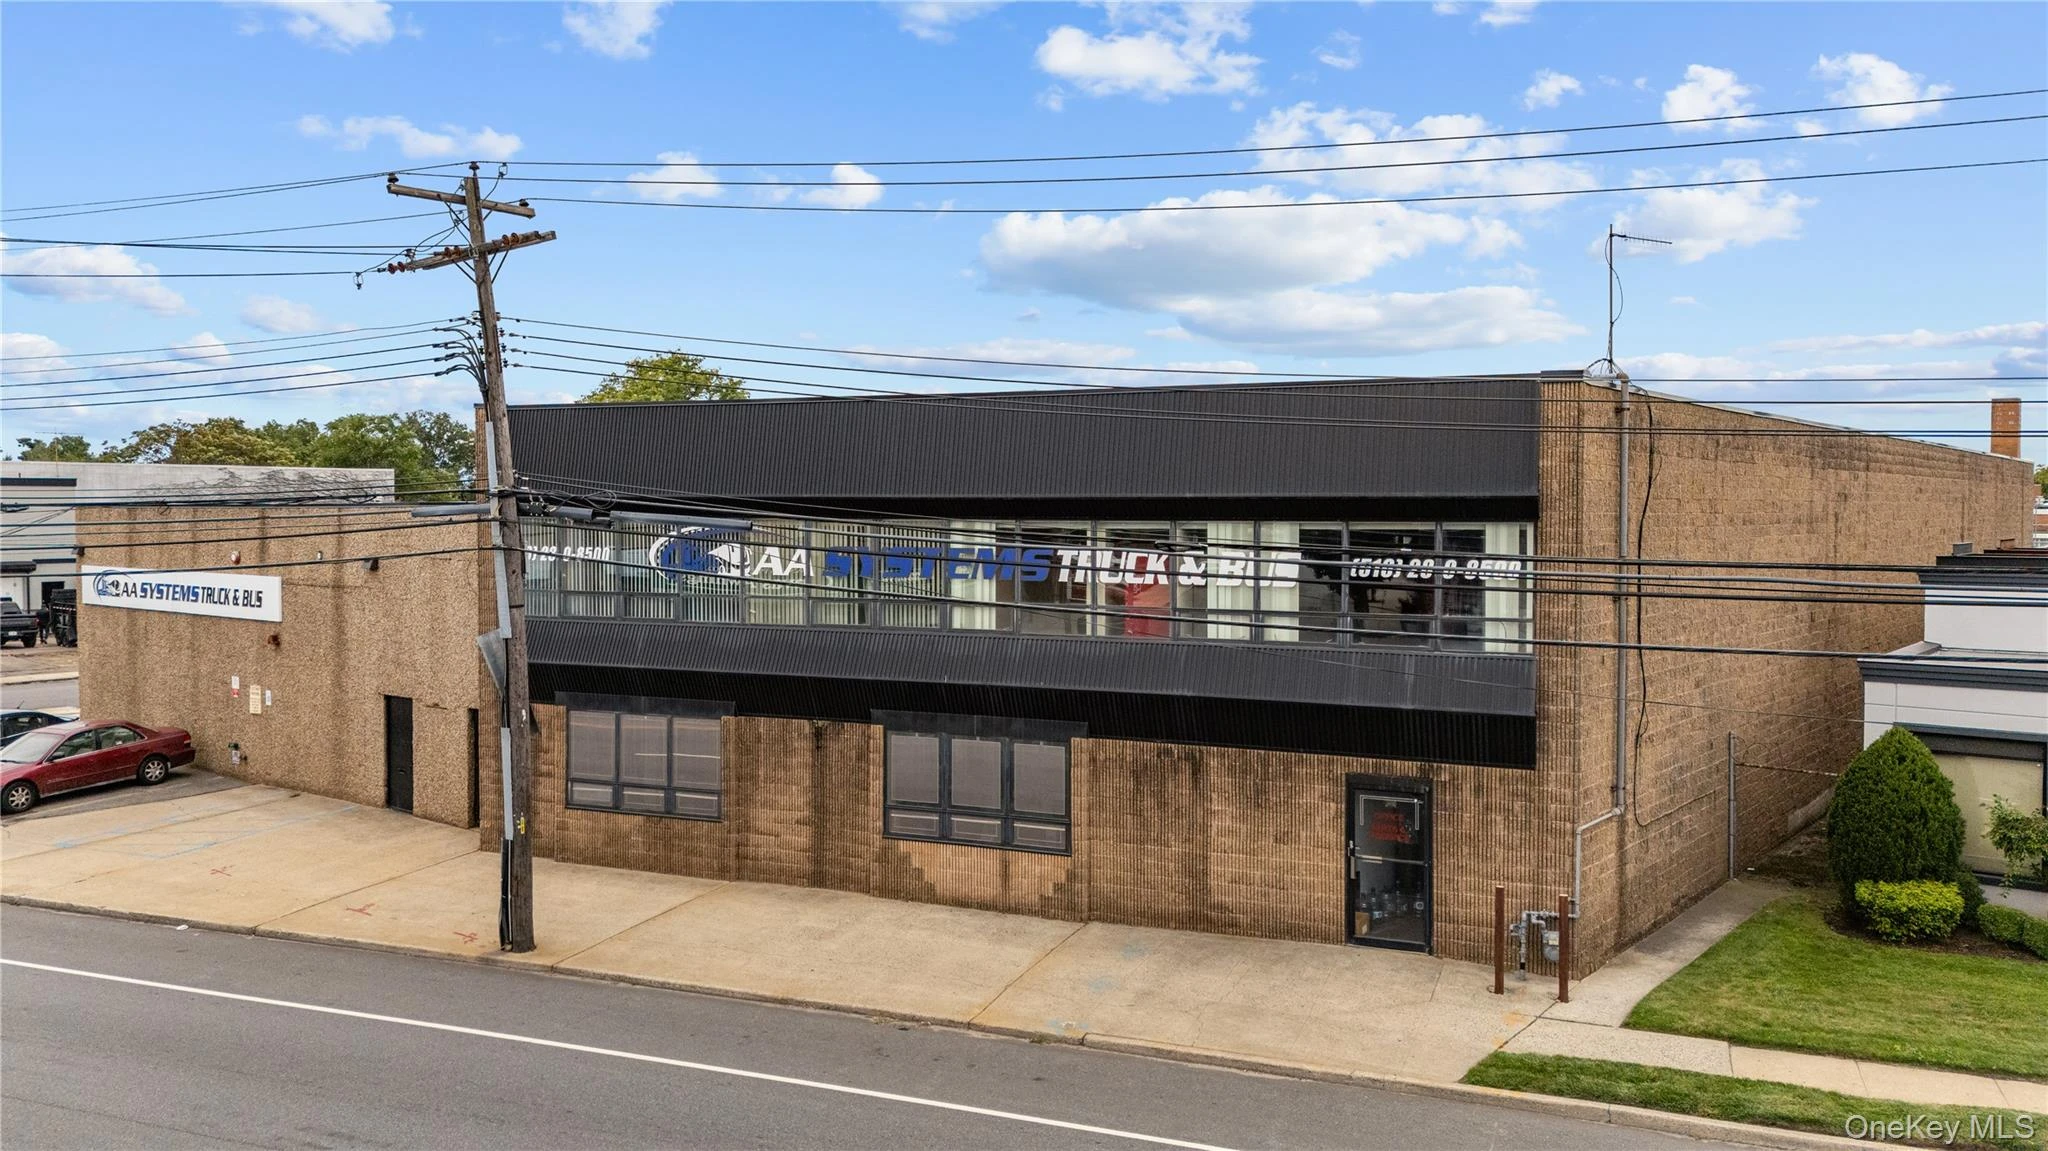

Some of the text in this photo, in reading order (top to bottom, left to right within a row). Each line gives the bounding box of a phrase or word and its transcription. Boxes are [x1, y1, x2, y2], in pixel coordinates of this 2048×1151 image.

[752, 546, 1302, 588] AA SYSTEMS TRUCK & BUS
[121, 582, 263, 608] AA SYSTEMS TRUCK & BUS
